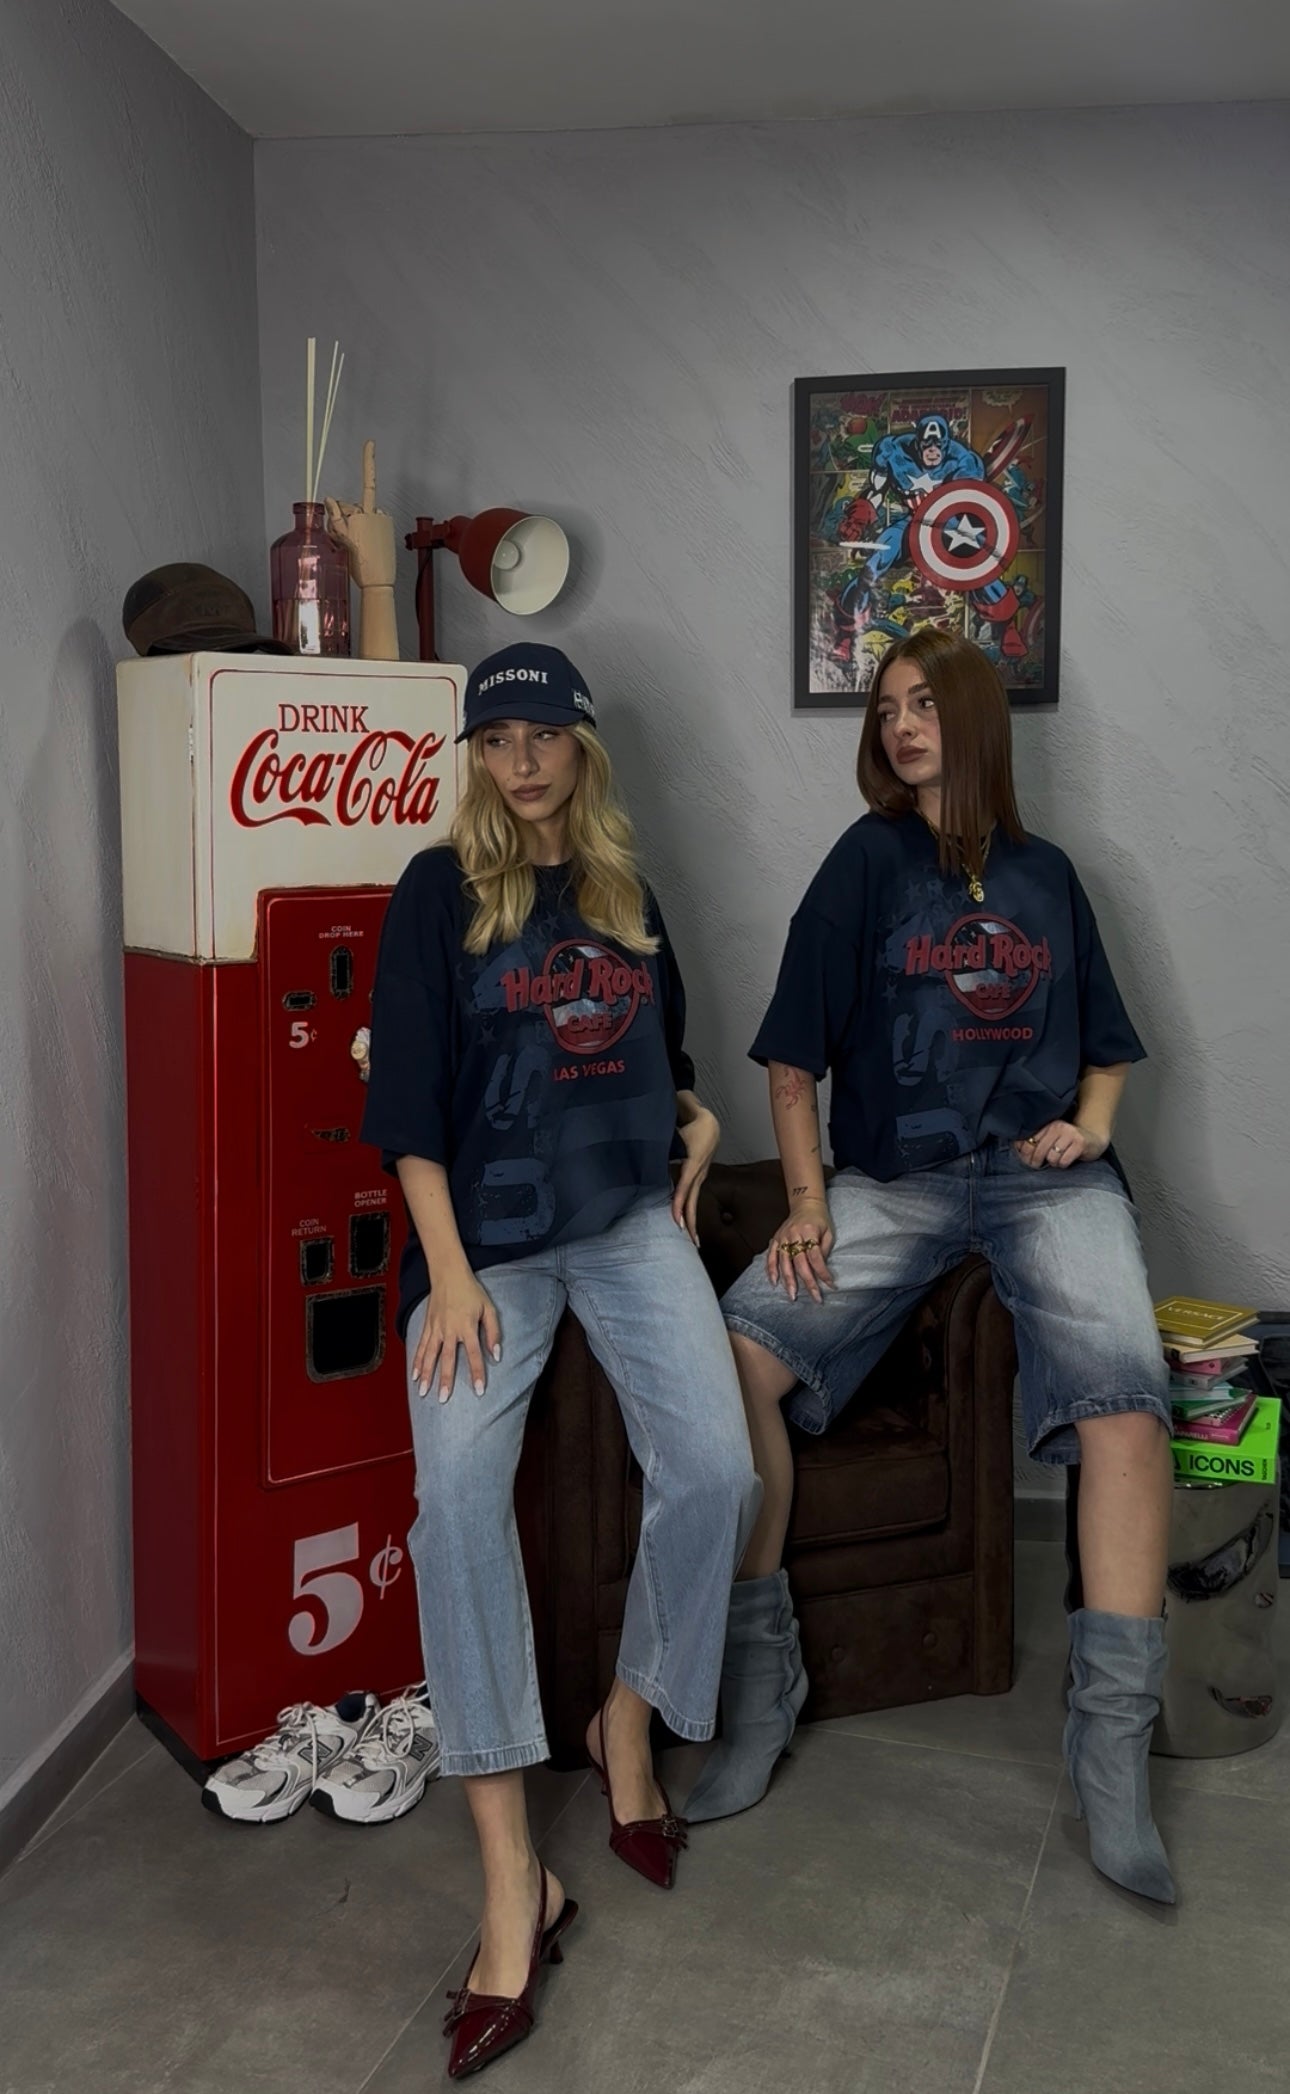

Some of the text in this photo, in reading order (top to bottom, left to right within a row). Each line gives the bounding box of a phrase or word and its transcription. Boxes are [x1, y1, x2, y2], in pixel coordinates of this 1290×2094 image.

[478, 669, 549, 696] MISSONI
[278, 703, 370, 733] DRINK
[230, 728, 446, 828] Coca-Cola
[318, 930, 364, 939] DROP HERE
[331, 925, 352, 933] COIN
[905, 933, 1053, 978] Hard Rock
[500, 958, 655, 1013] Hard Rock
[975, 983, 1011, 1000] CAFE
[567, 1012, 613, 1033] CAFE
[951, 1026, 1034, 1041] HOLLYWOOD
[553, 1059, 626, 1081] LAS VEGAS
[354, 1188, 388, 1200] BOTTLE
[354, 1197, 387, 1208] OPENER
[291, 1225, 327, 1237] RETURN
[299, 1218, 319, 1228] COIN
[1189, 1454, 1255, 1477] ICONS
